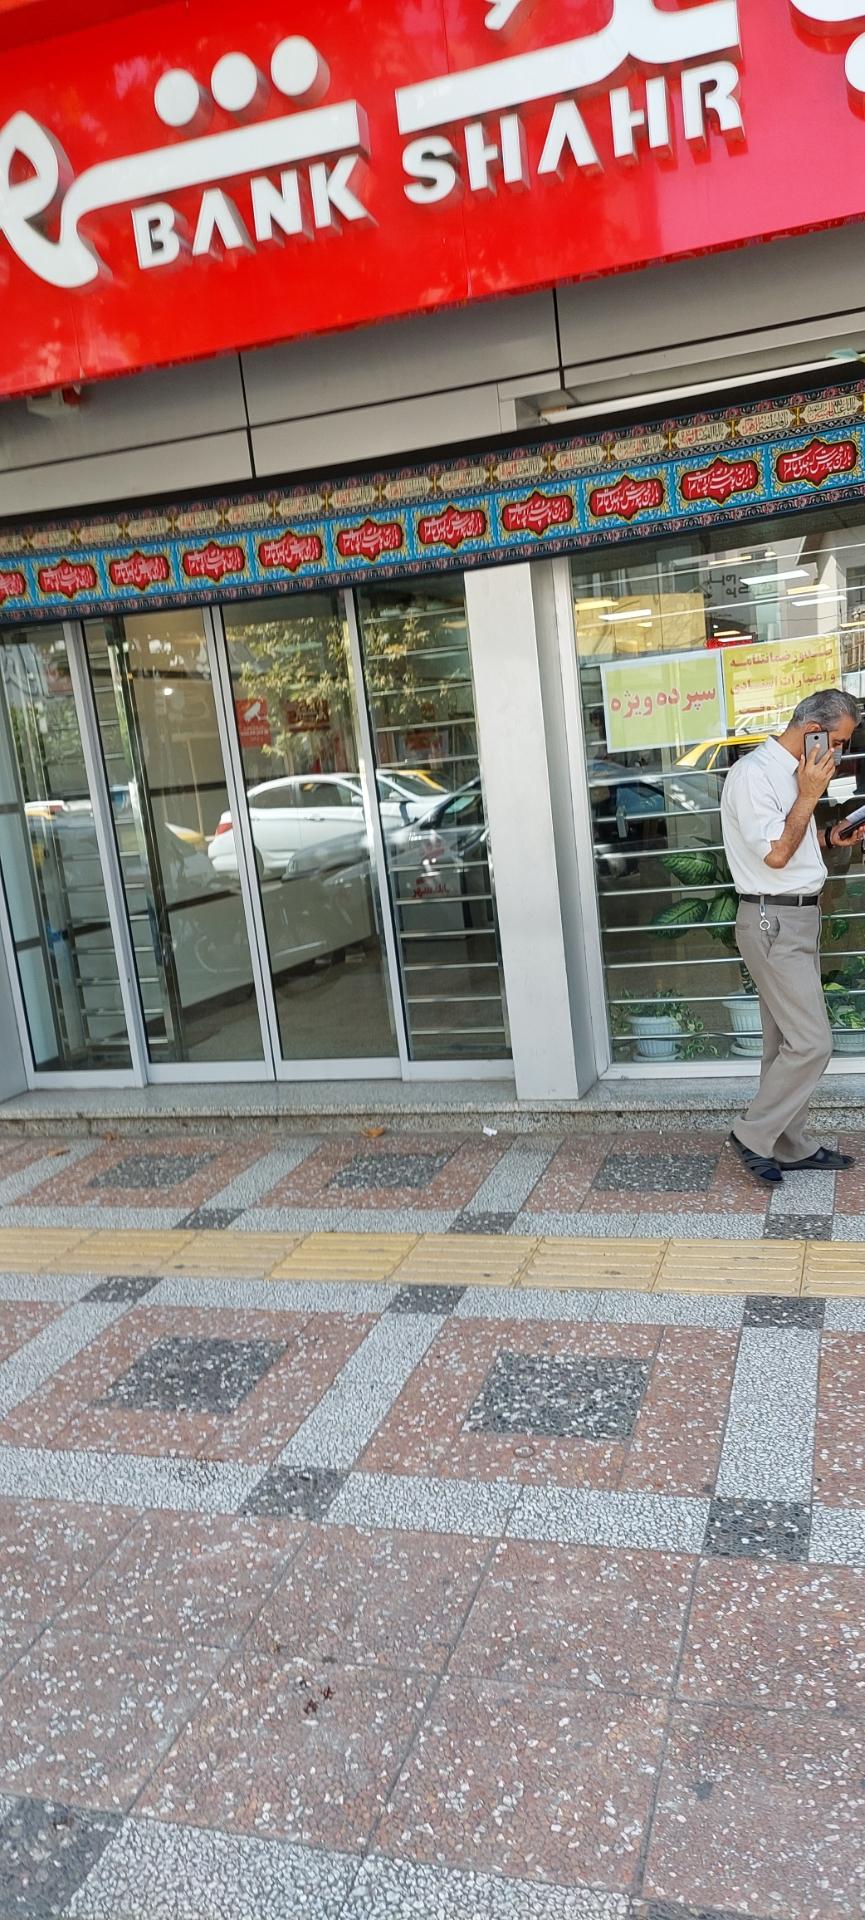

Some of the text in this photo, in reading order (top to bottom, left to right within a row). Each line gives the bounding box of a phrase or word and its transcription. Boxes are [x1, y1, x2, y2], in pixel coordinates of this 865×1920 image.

[130, 59, 744, 270] BANK SHAHR
[610, 690, 654, 719] ویژه
[656, 687, 717, 712] سپرده
